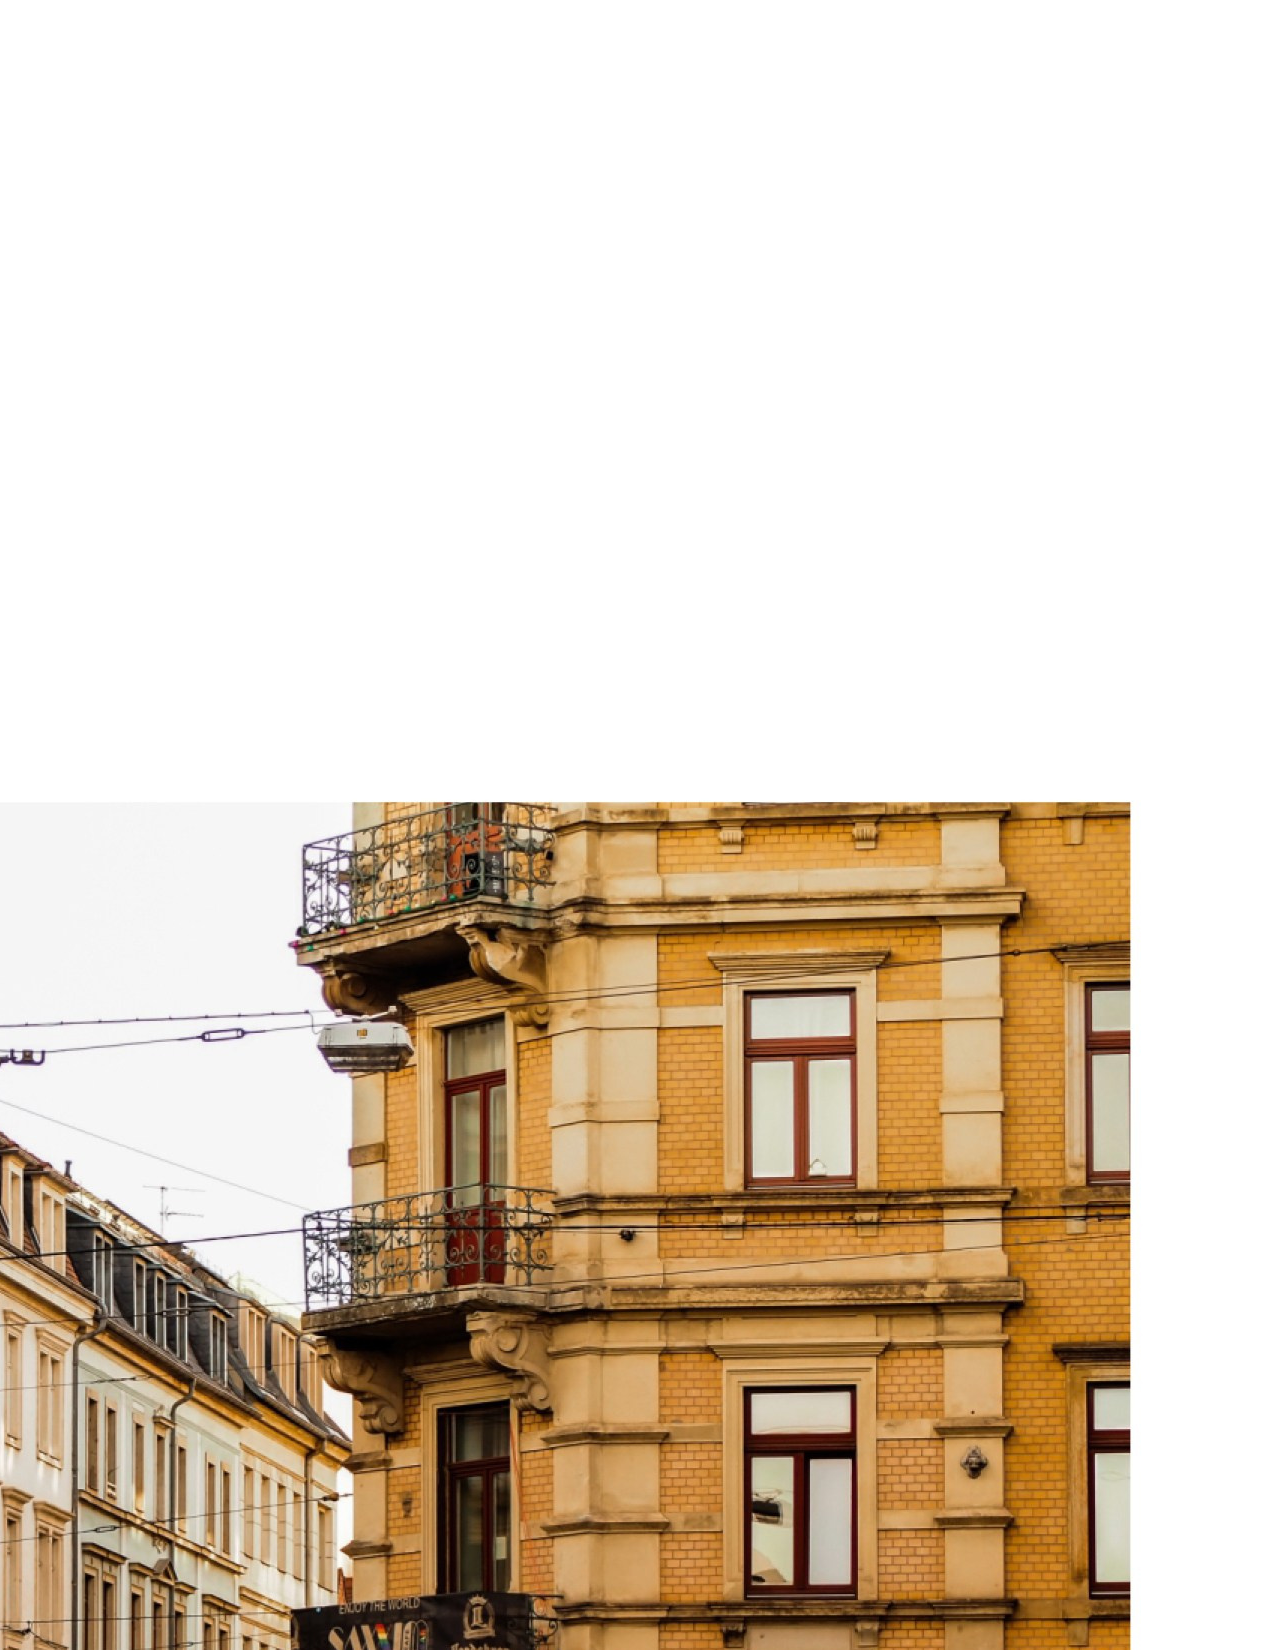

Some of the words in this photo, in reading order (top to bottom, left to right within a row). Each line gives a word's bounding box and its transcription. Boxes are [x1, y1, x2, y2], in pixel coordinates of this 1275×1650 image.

[339, 1601, 367, 1615] ENJOY
[369, 1600, 386, 1612] THE
[388, 1597, 420, 1611] WORLD
